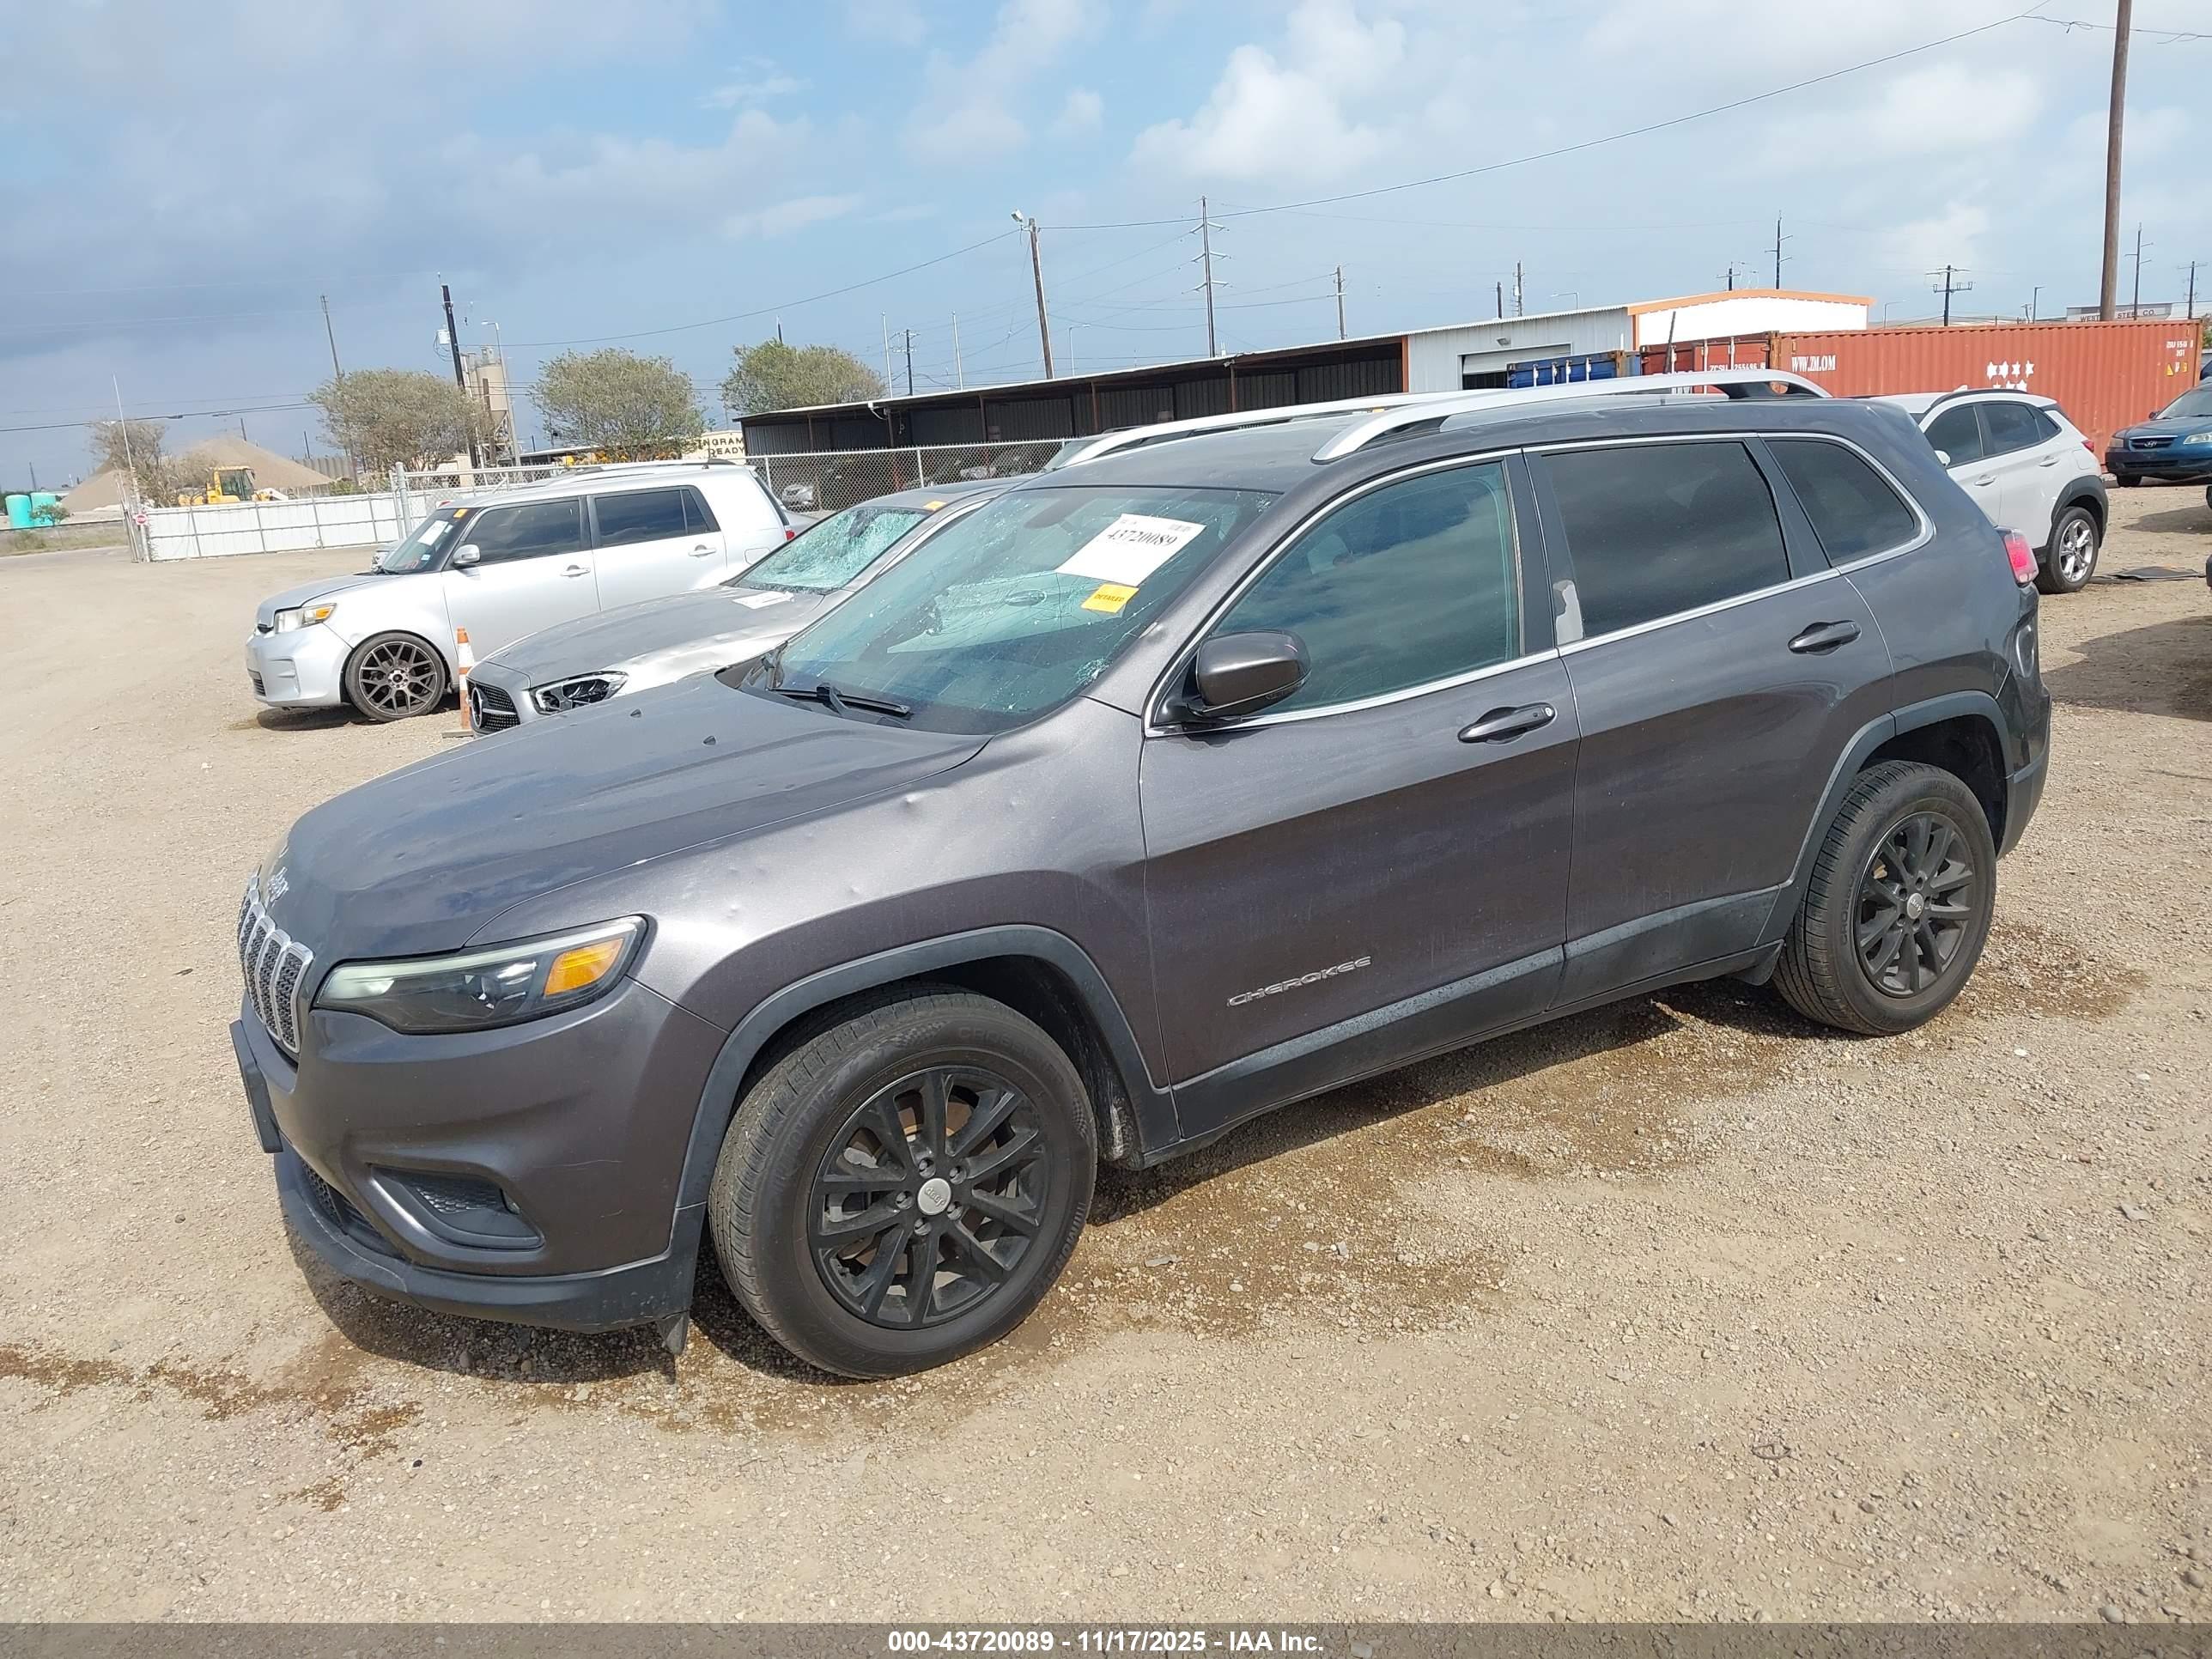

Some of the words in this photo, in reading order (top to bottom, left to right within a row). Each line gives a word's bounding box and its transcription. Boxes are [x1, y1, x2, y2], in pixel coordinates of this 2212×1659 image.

[1107, 529, 1177, 546] 43720089
[1228, 956, 1371, 1007] CHEROKEE
[925, 1187, 945, 1207] Jeep
